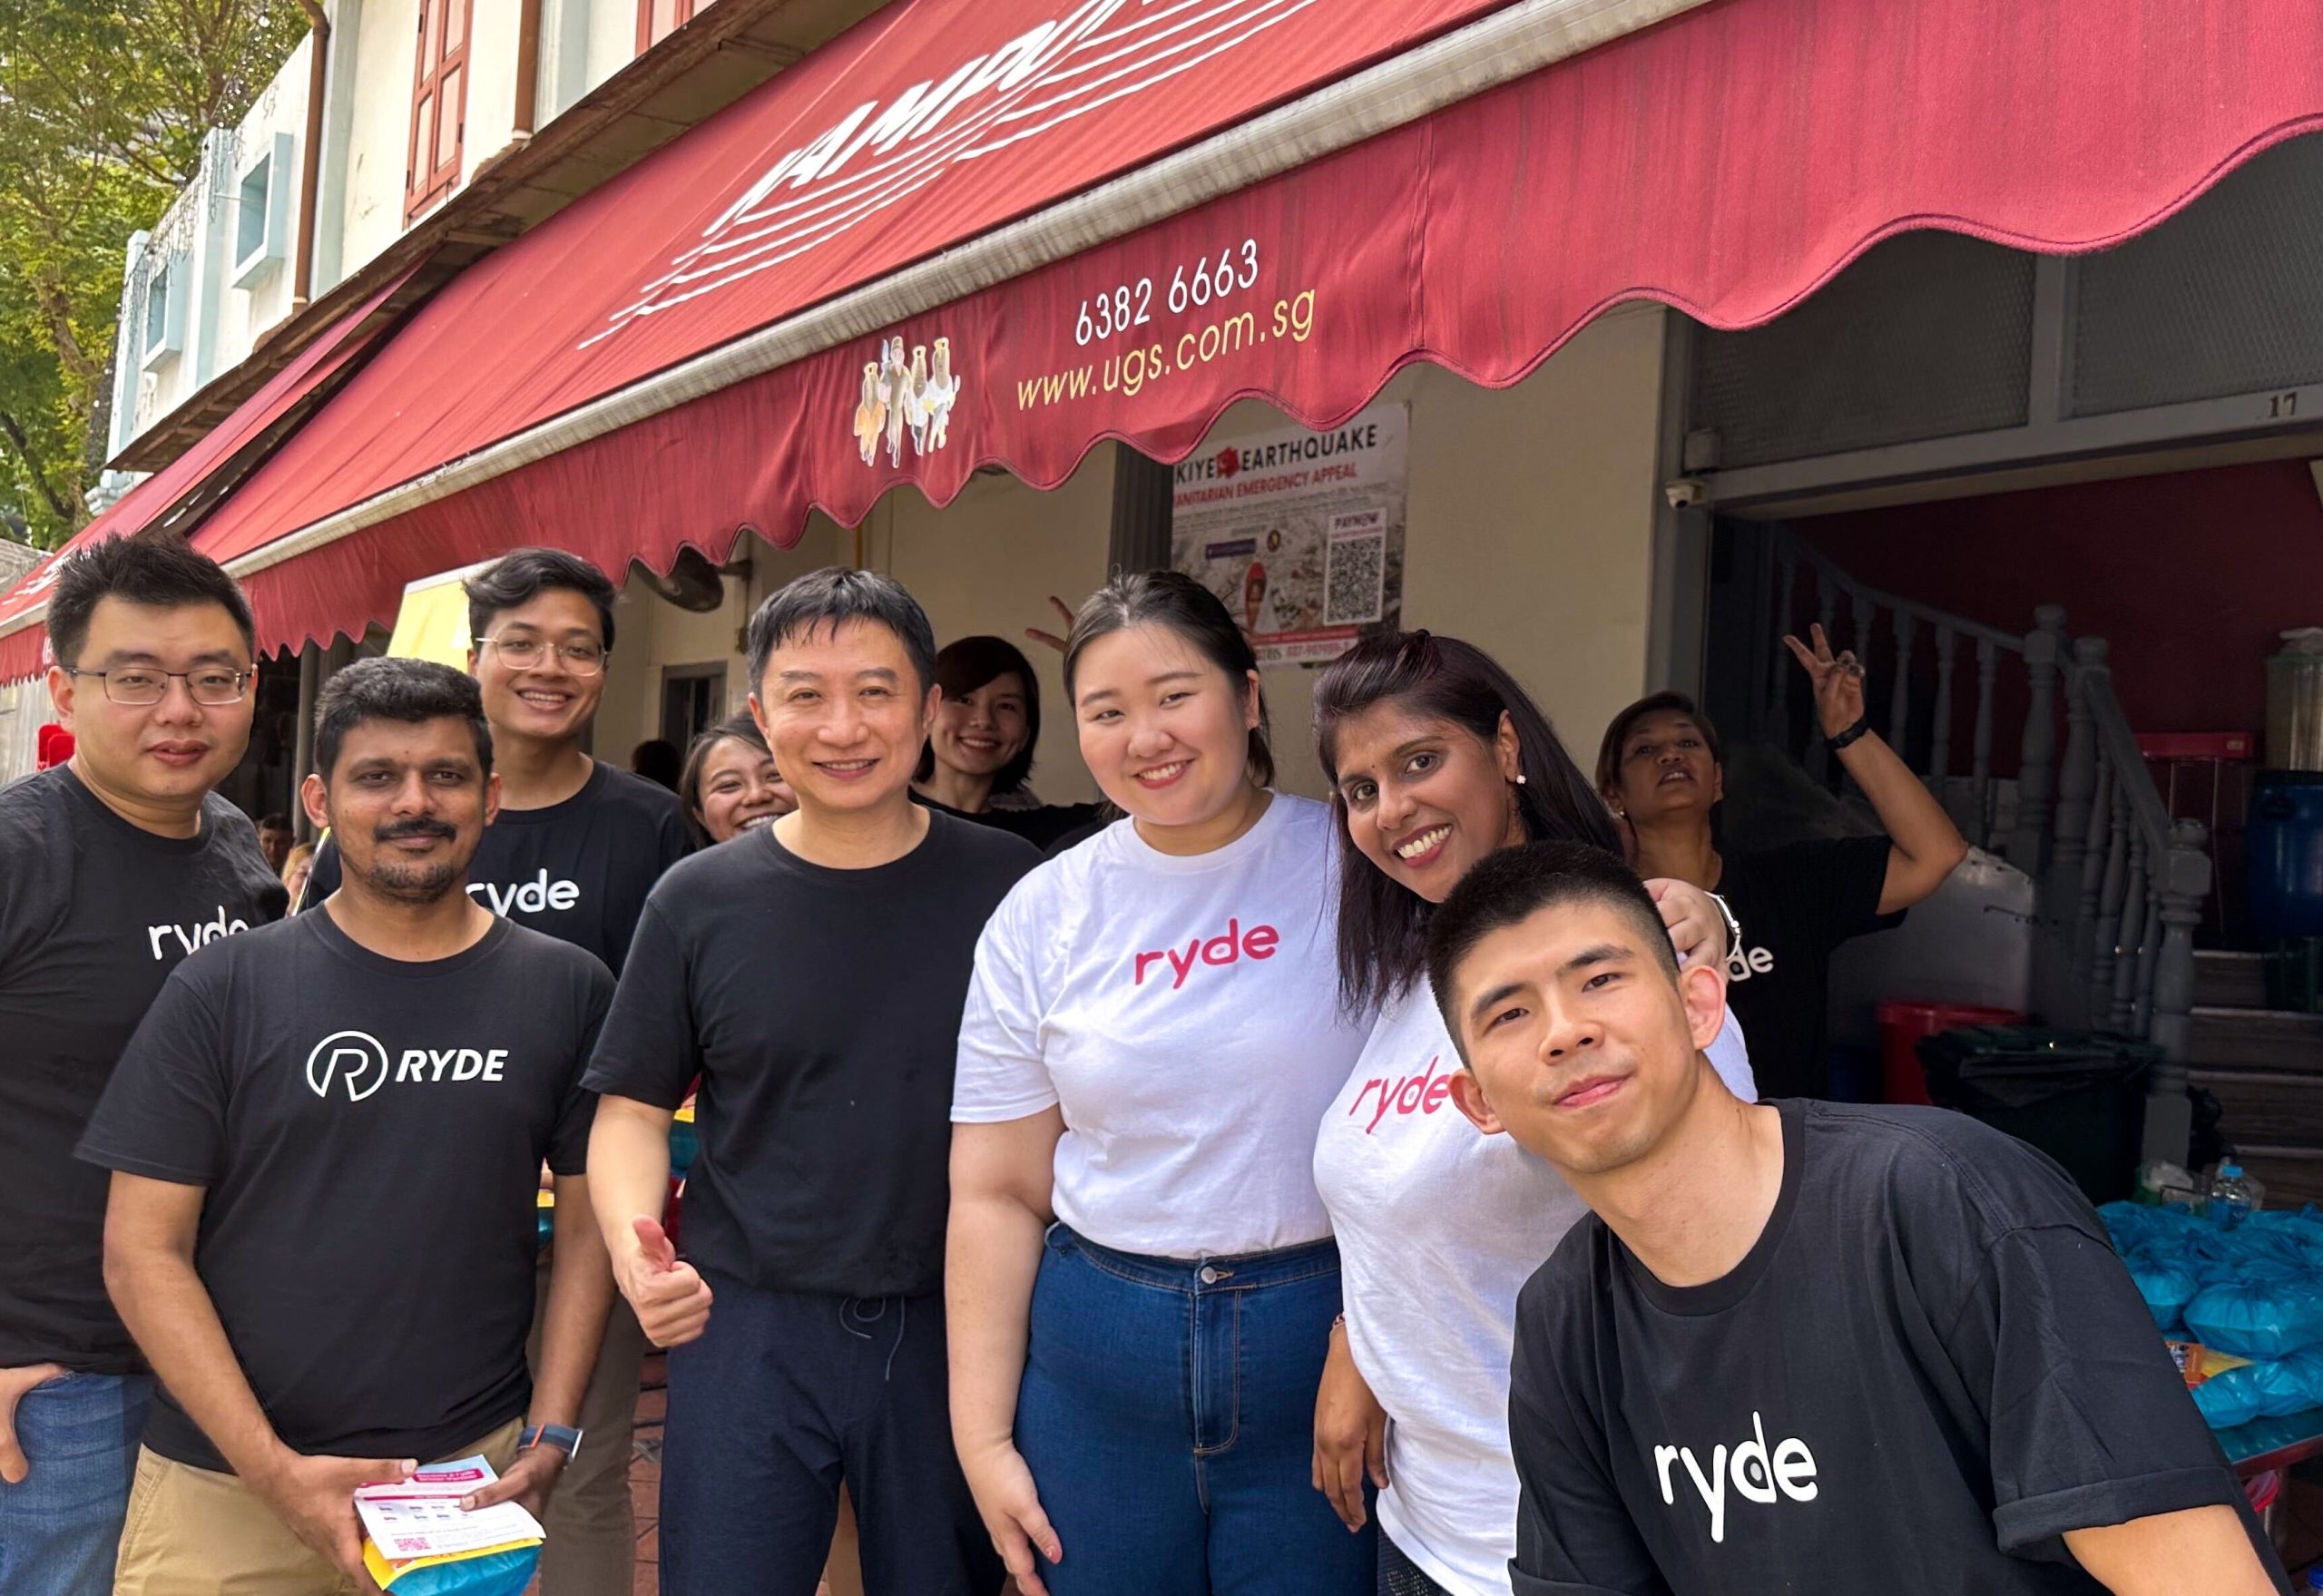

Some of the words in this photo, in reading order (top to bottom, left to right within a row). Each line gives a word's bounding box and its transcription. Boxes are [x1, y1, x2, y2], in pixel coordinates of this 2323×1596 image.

[1074, 277, 1152, 347] 6382
[1168, 239, 1259, 314] 6663
[1017, 289, 1316, 410] www.ugs.com.sg
[2269, 391, 2298, 417] 17
[1174, 485, 1234, 508] ANITARIAN
[1236, 470, 1309, 498] EMERGENCY
[1311, 462, 1358, 485] APPEAL
[1175, 457, 1216, 485] KIYE
[1241, 424, 1377, 472] EARTHQUAKE
[1135, 917, 1279, 990] ryde
[1726, 942, 1775, 982] de
[395, 1048, 509, 1082] RYDE
[1348, 1055, 1451, 1134] ryde
[1653, 1410, 1818, 1542] ryde
